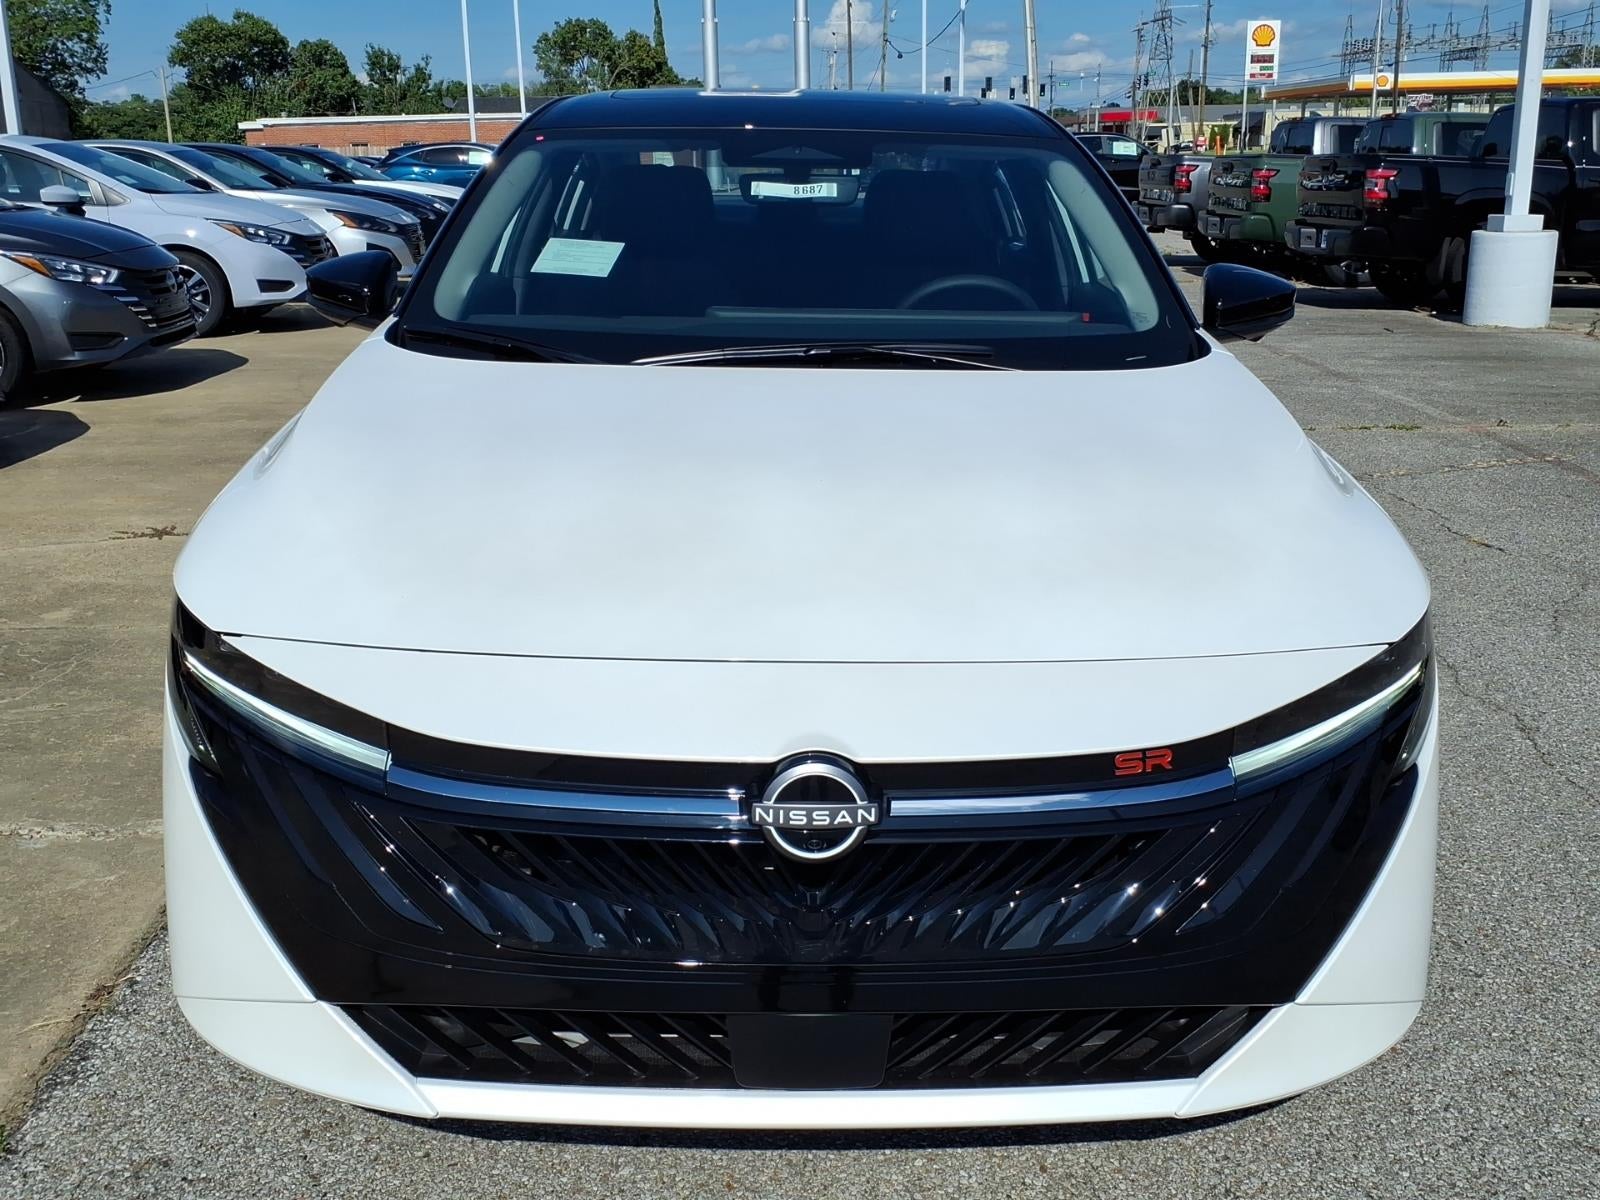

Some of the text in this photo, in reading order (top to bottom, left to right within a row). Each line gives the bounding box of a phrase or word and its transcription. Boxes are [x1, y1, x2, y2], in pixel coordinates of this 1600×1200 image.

[793, 185, 823, 195] 8687
[1114, 748, 1173, 776] SR
[755, 807, 876, 825] NISSAN
